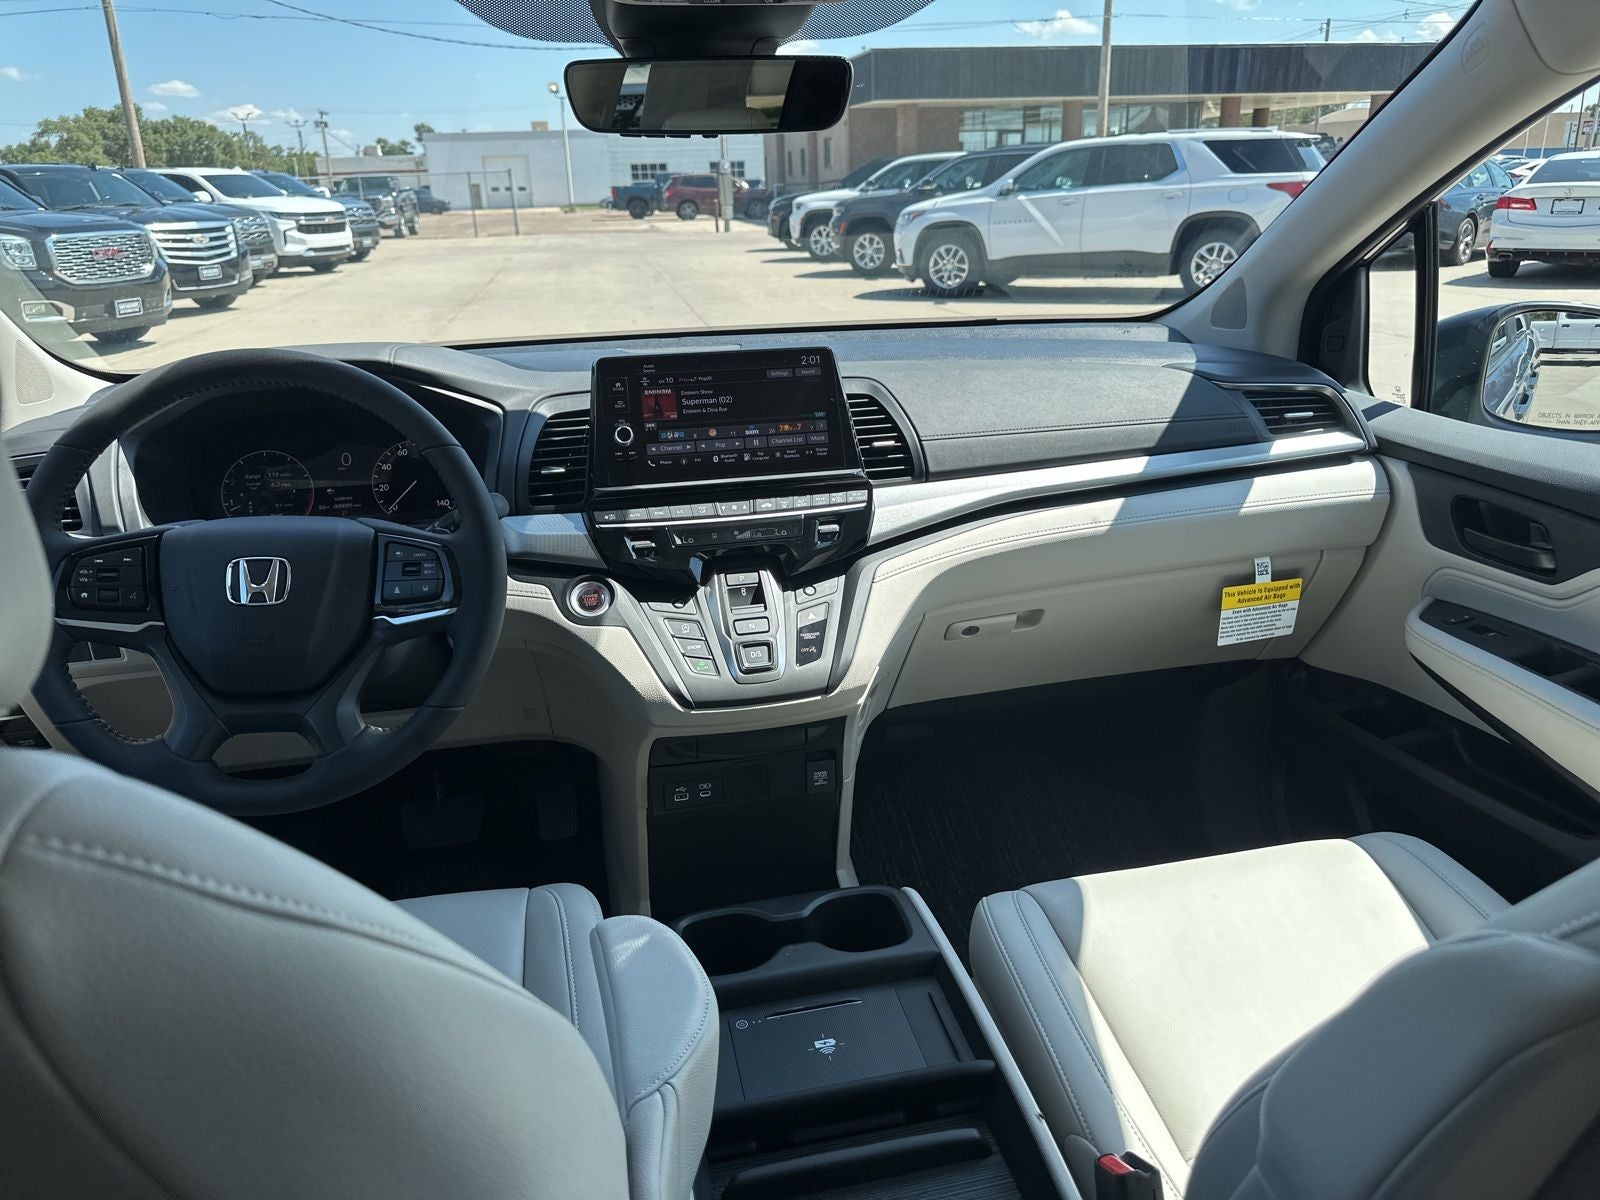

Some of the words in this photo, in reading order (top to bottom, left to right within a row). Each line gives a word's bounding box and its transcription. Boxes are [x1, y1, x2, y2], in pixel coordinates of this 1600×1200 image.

[800, 356, 820, 364] 2:01
[682, 398, 717, 406] Superman
[341, 452, 351, 466] 0
[1264, 584, 1288, 593] Equipped
